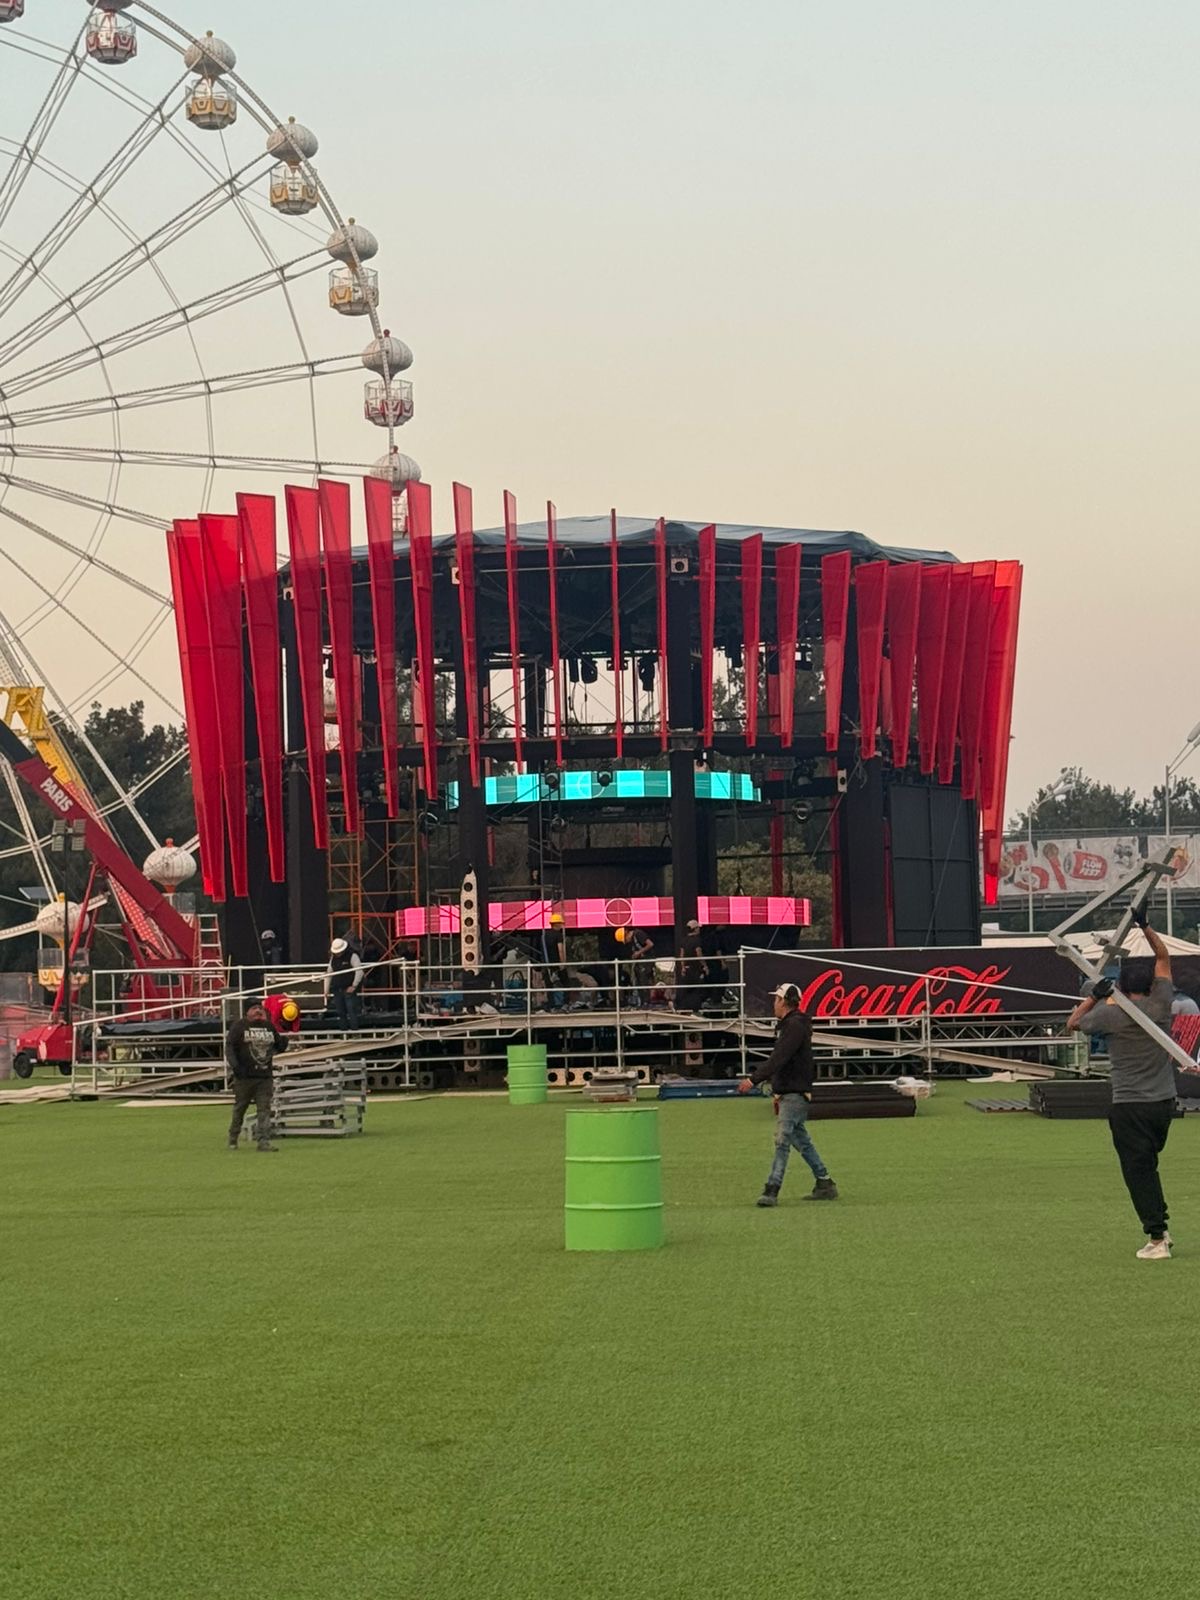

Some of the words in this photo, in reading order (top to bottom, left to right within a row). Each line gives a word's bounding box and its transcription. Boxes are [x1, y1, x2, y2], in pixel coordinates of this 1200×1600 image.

[40, 777, 74, 812] PARIS
[1079, 868, 1101, 877] FEST
[798, 965, 1013, 1017] Coca-Cola
